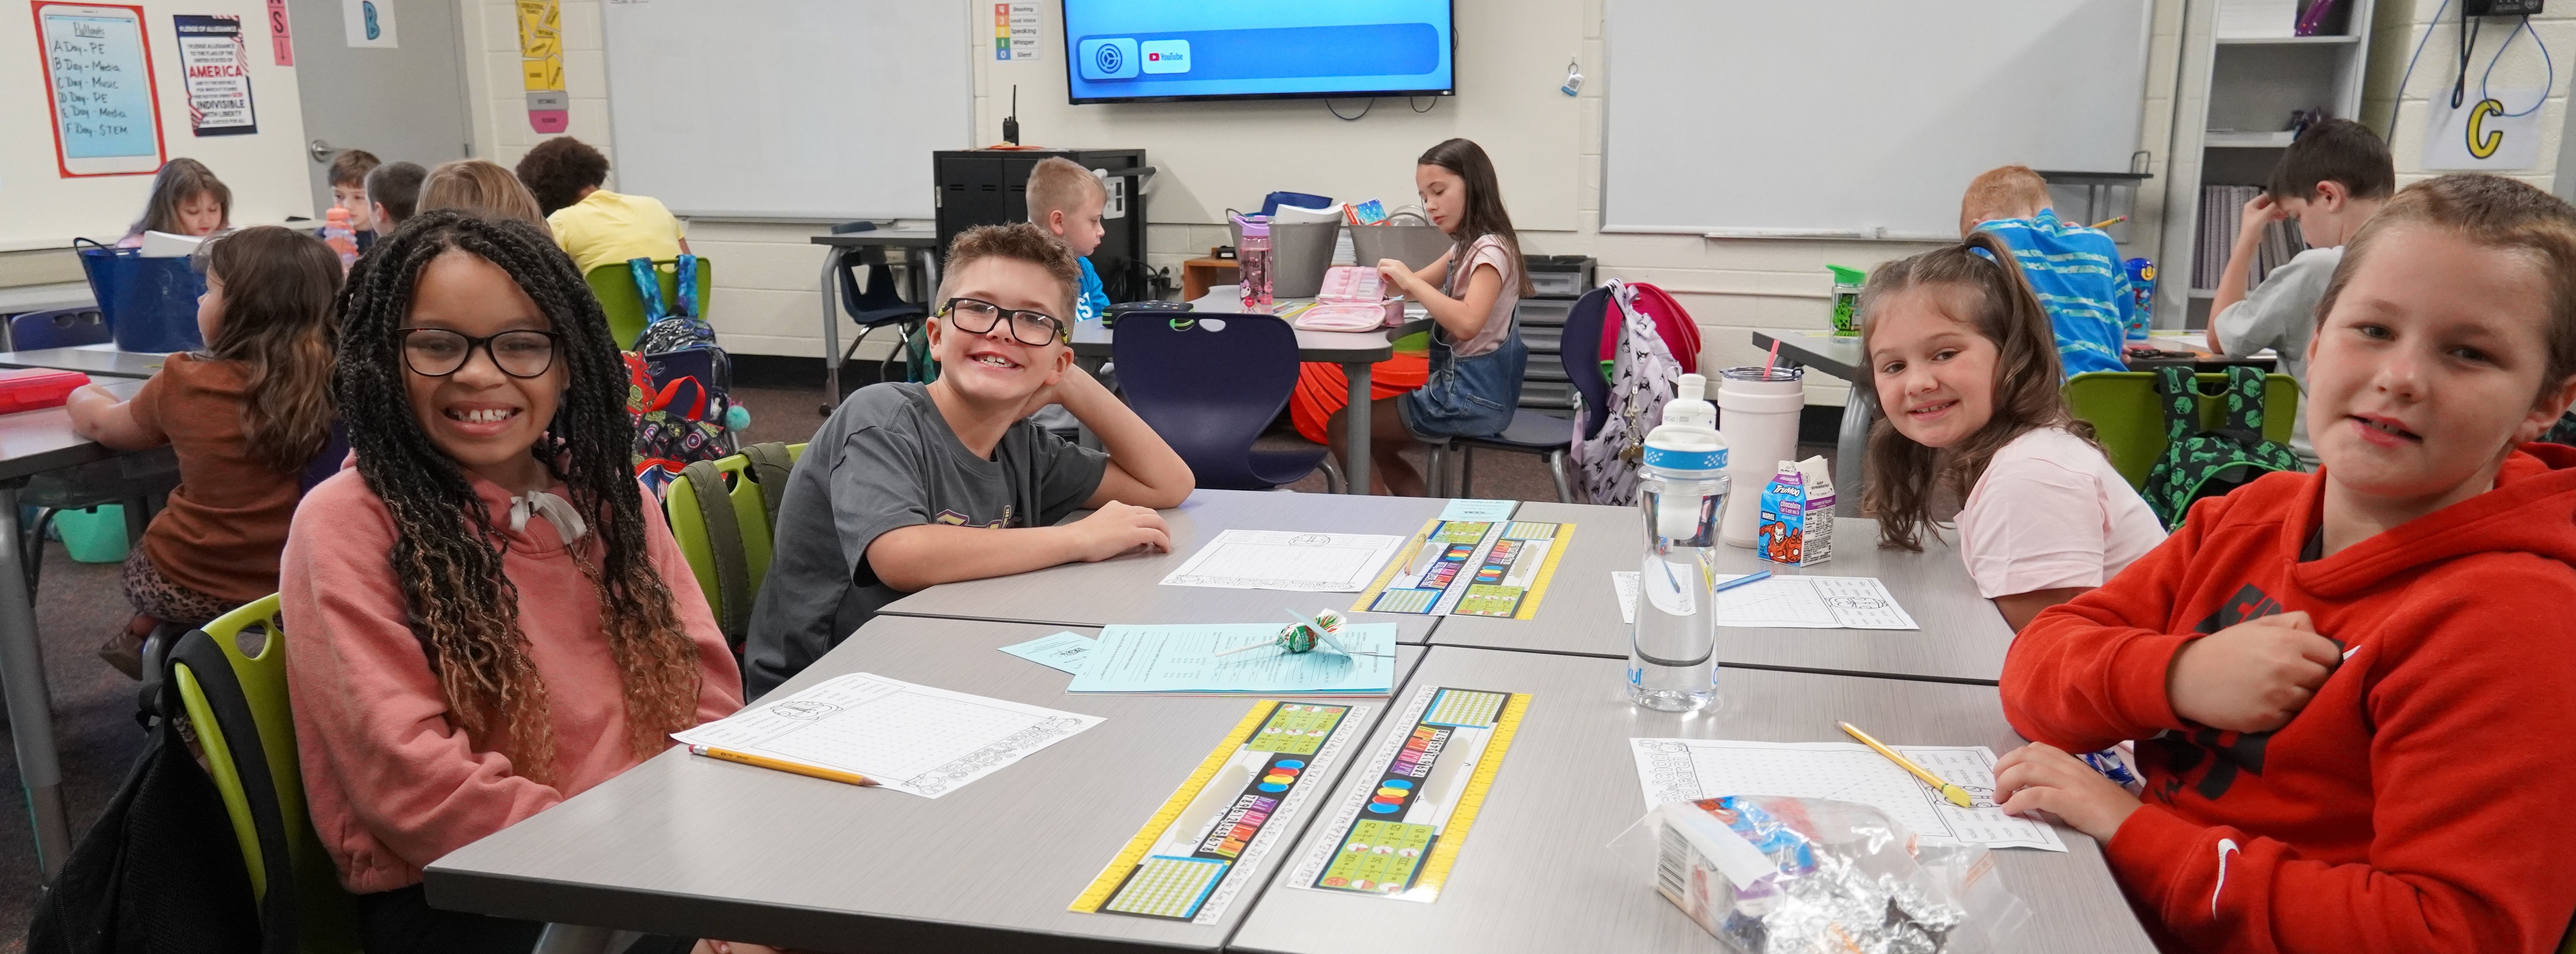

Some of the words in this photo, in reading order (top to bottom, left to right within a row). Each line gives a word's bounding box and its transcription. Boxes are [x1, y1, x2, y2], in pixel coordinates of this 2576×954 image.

[999, 6, 1005, 14] 4
[362, 0, 380, 40] B
[54, 40, 63, 52] A
[90, 43, 105, 54] PE
[1001, 39, 1005, 48] 1
[1000, 50, 1007, 59] 0
[1160, 52, 1183, 61] YouTube
[55, 57, 62, 70] B
[64, 59, 82, 73] Day
[92, 61, 121, 72] Media
[189, 66, 243, 78] AMERICA
[65, 77, 82, 90] Day
[92, 76, 118, 89] Music
[93, 91, 108, 103] PE
[196, 100, 245, 109] INDIVISIBLE
[70, 106, 89, 119] Day
[99, 108, 128, 118] Media
[66, 123, 73, 134] F
[100, 124, 127, 136] STEM
[2466, 98, 2504, 159] C
[1773, 485, 1801, 497] TruMoo
[1780, 500, 1801, 510] chocolate
[1762, 511, 1775, 521] MARVEL
[995, 727, 1042, 748] Word
[1017, 729, 1069, 750] Back
[935, 747, 1000, 775] Search
[942, 750, 1017, 782] School
[1964, 755, 1976, 765] books
[1645, 751, 1677, 786] School
[1668, 757, 1697, 788] Search
[1944, 769, 1955, 782] writing
[1956, 769, 1974, 784] backpack
[1975, 770, 1989, 784] reading
